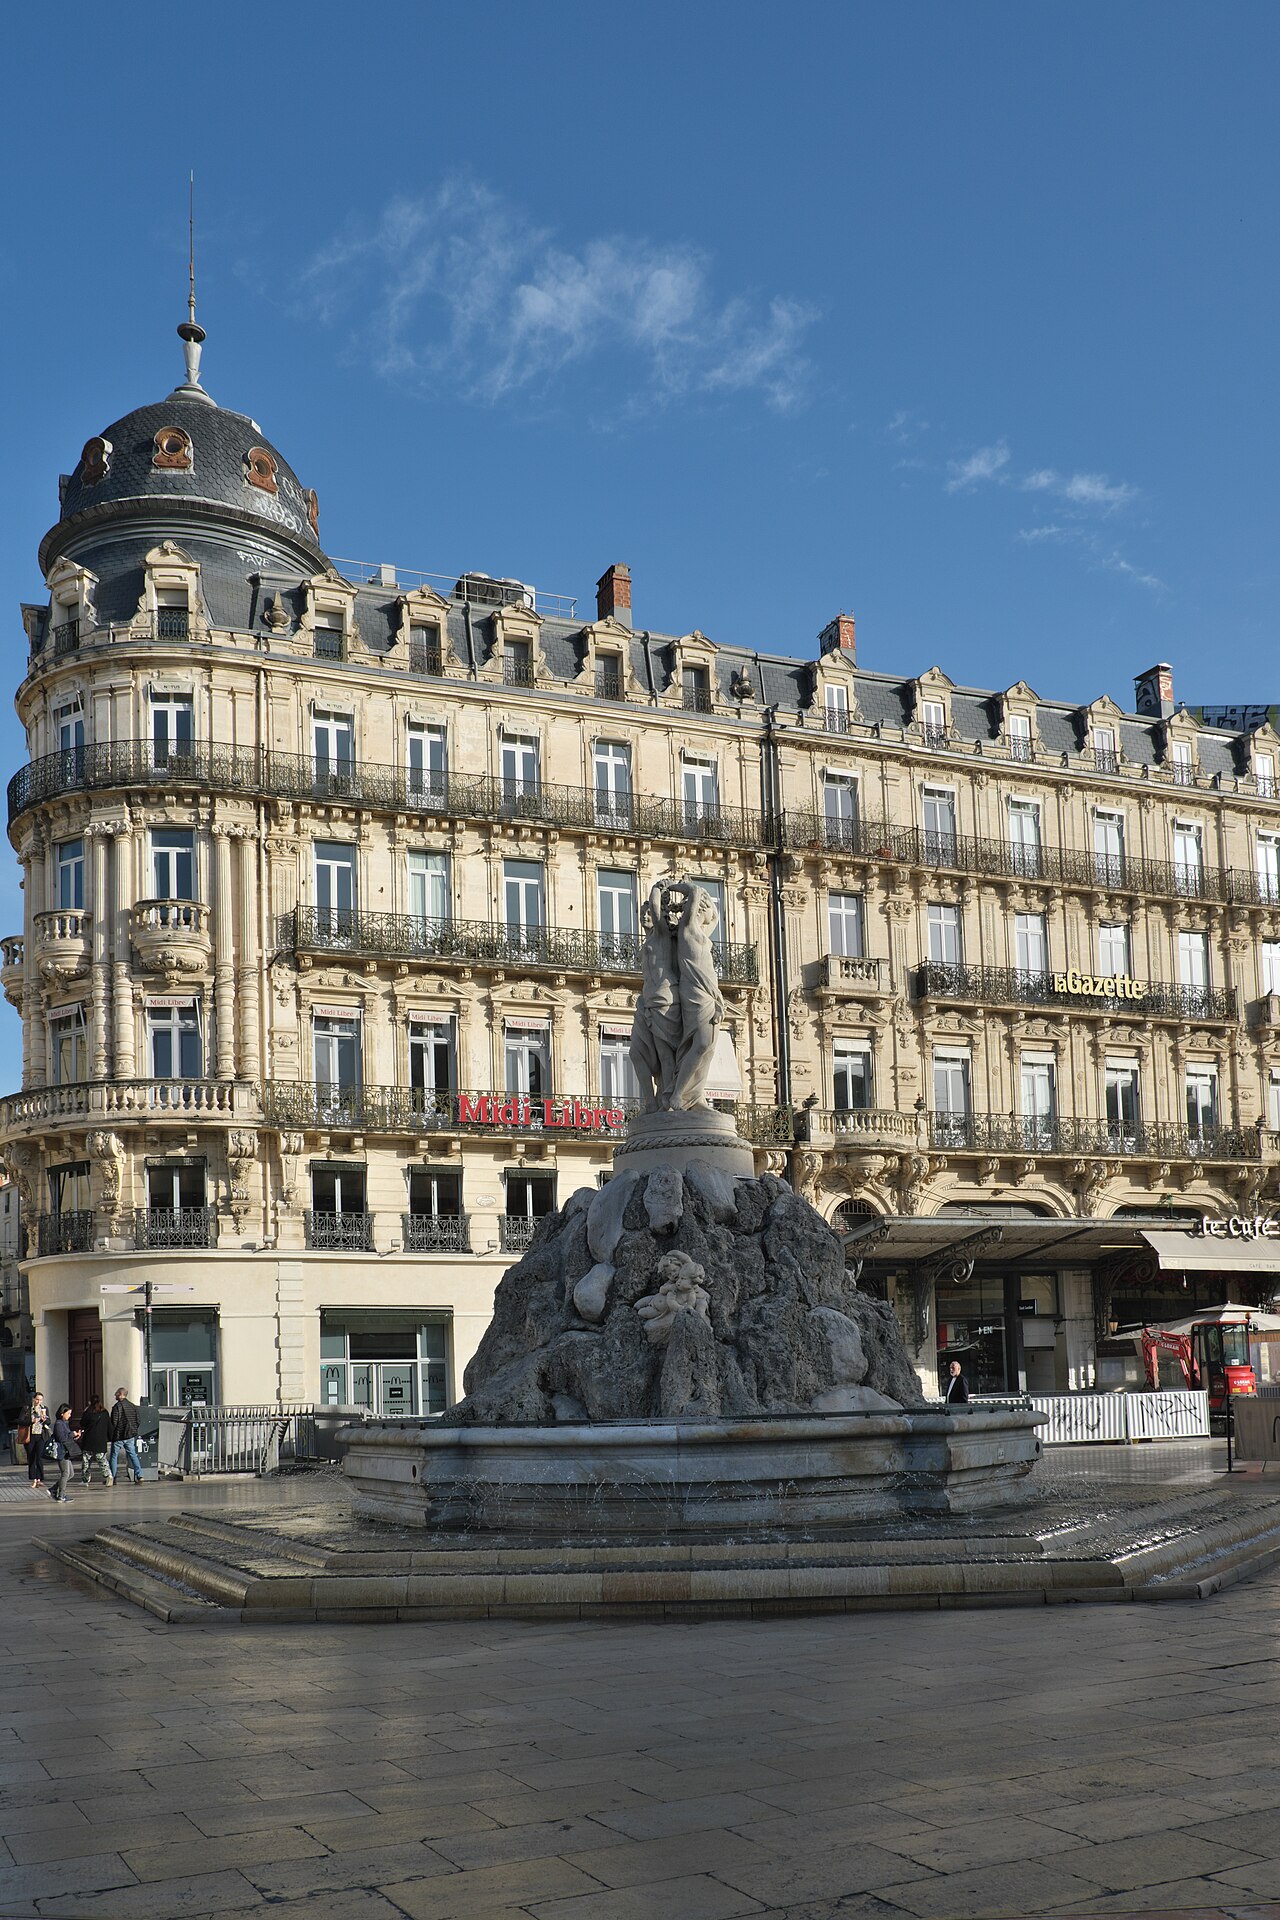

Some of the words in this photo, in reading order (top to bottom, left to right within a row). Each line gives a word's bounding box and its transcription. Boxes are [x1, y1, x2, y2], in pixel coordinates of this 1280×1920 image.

[320, 1008, 336, 1016] Midi
[337, 1009, 354, 1017] Libre
[411, 1013, 426, 1021] Midi
[427, 1014, 444, 1022] Libre
[456, 1094, 531, 1125] Midi
[543, 1100, 623, 1129] Libre
[1202, 1215, 1218, 1235] le
[1229, 1215, 1271, 1240] Café
